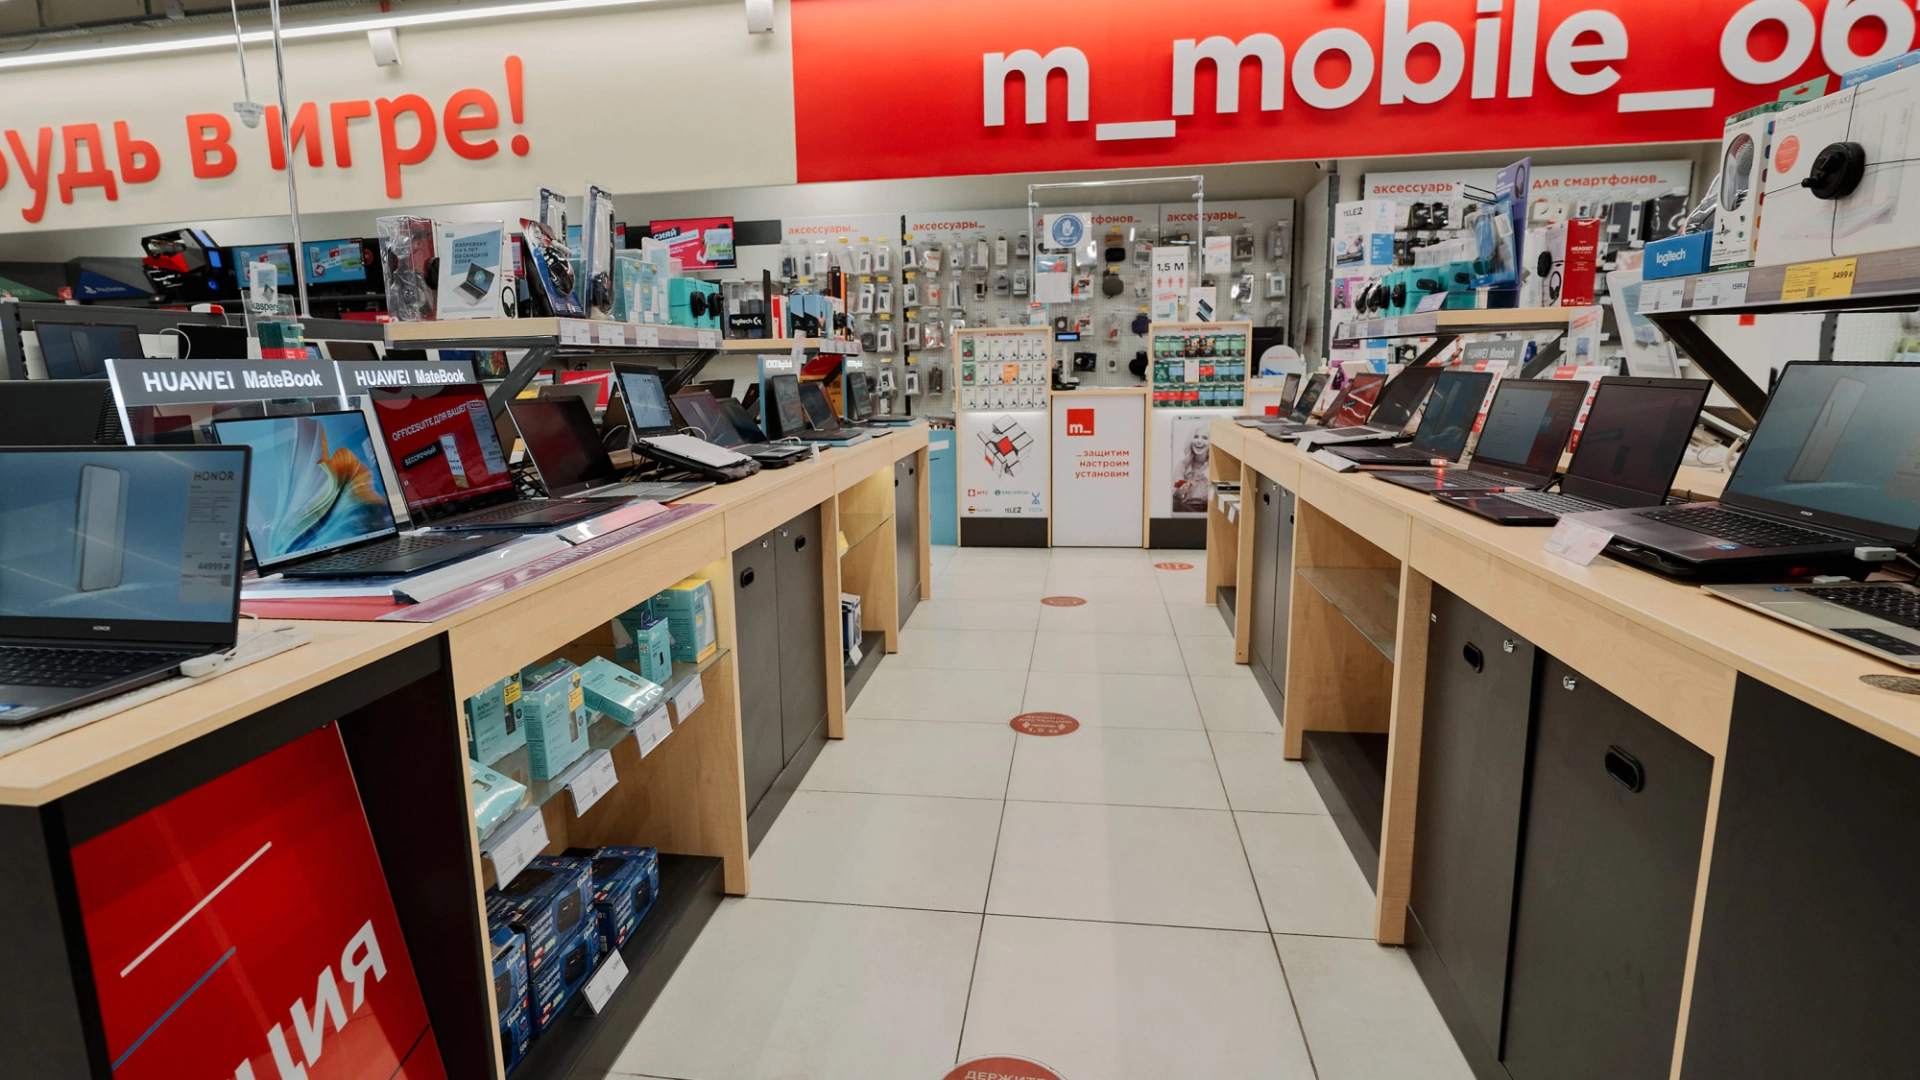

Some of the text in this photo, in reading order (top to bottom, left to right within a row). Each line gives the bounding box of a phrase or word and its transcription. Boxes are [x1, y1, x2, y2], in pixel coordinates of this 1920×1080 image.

[0, 55, 530, 223] удь в игре!
[1532, 178, 1559, 190] для
[1343, 207, 1363, 217] TELE2
[1656, 247, 1686, 267] logitech
[1832, 270, 1849, 280] 3499
[251, 301, 289, 315] kaspersky
[731, 317, 753, 326] logitech
[143, 369, 323, 392] HUAWEI MateBook
[354, 368, 466, 387] HUAWEI MateBook
[392, 416, 434, 441] OFFICESUITE
[404, 445, 436, 466] БЕССРОЧНЫЙ
[1080, 460, 1129, 468] настроим
[193, 471, 235, 481] HONOR
[1075, 471, 1129, 479] установим
[477, 701, 491, 712] Archer
